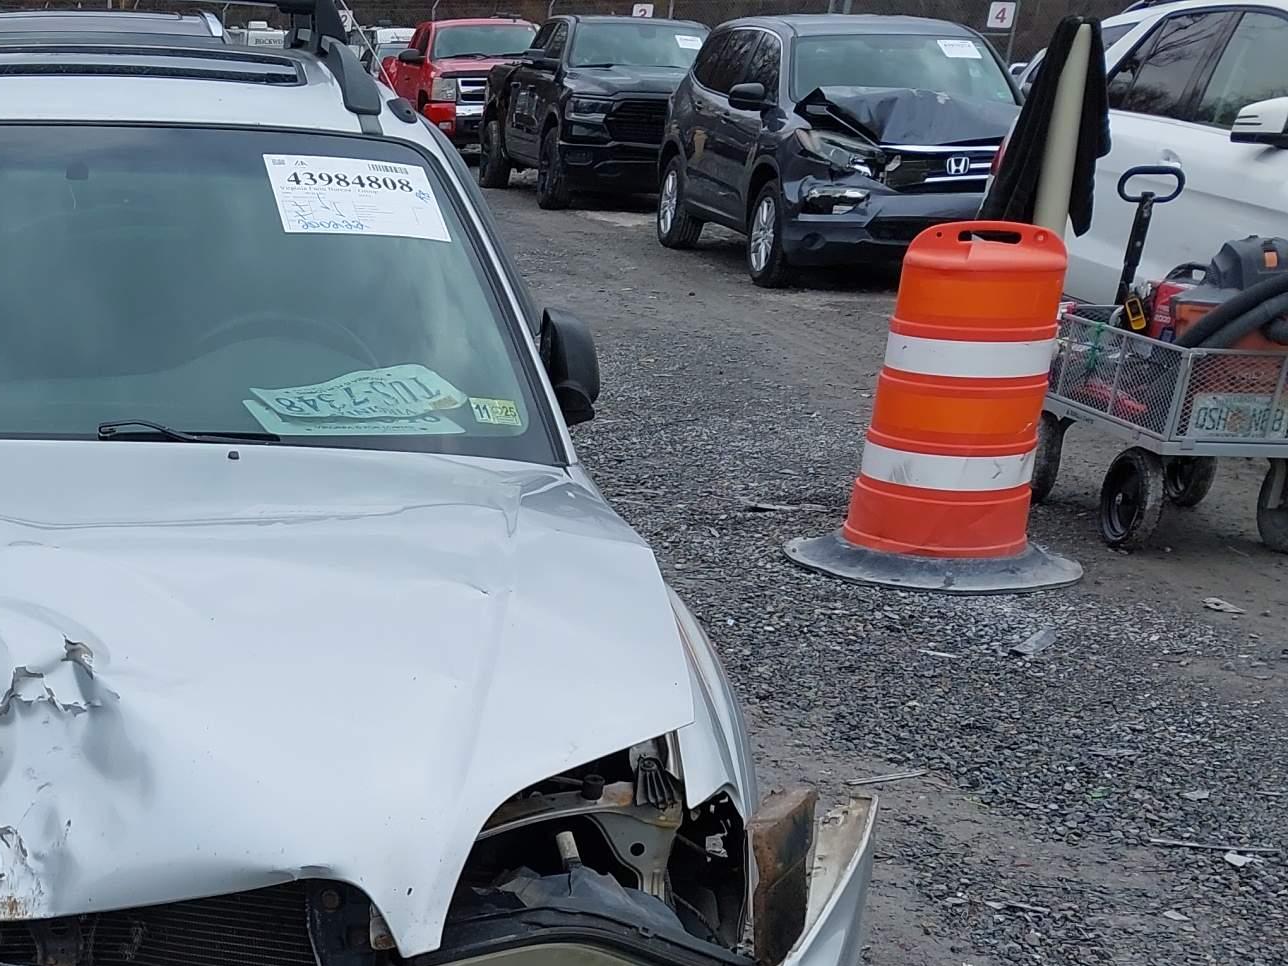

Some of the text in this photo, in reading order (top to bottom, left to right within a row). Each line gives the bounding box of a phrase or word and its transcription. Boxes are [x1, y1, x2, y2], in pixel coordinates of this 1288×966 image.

[994, 7, 1007, 24] 4
[287, 171, 414, 193] 43984808
[275, 376, 441, 413] TUS-7348
[474, 404, 517, 419] 11 25
